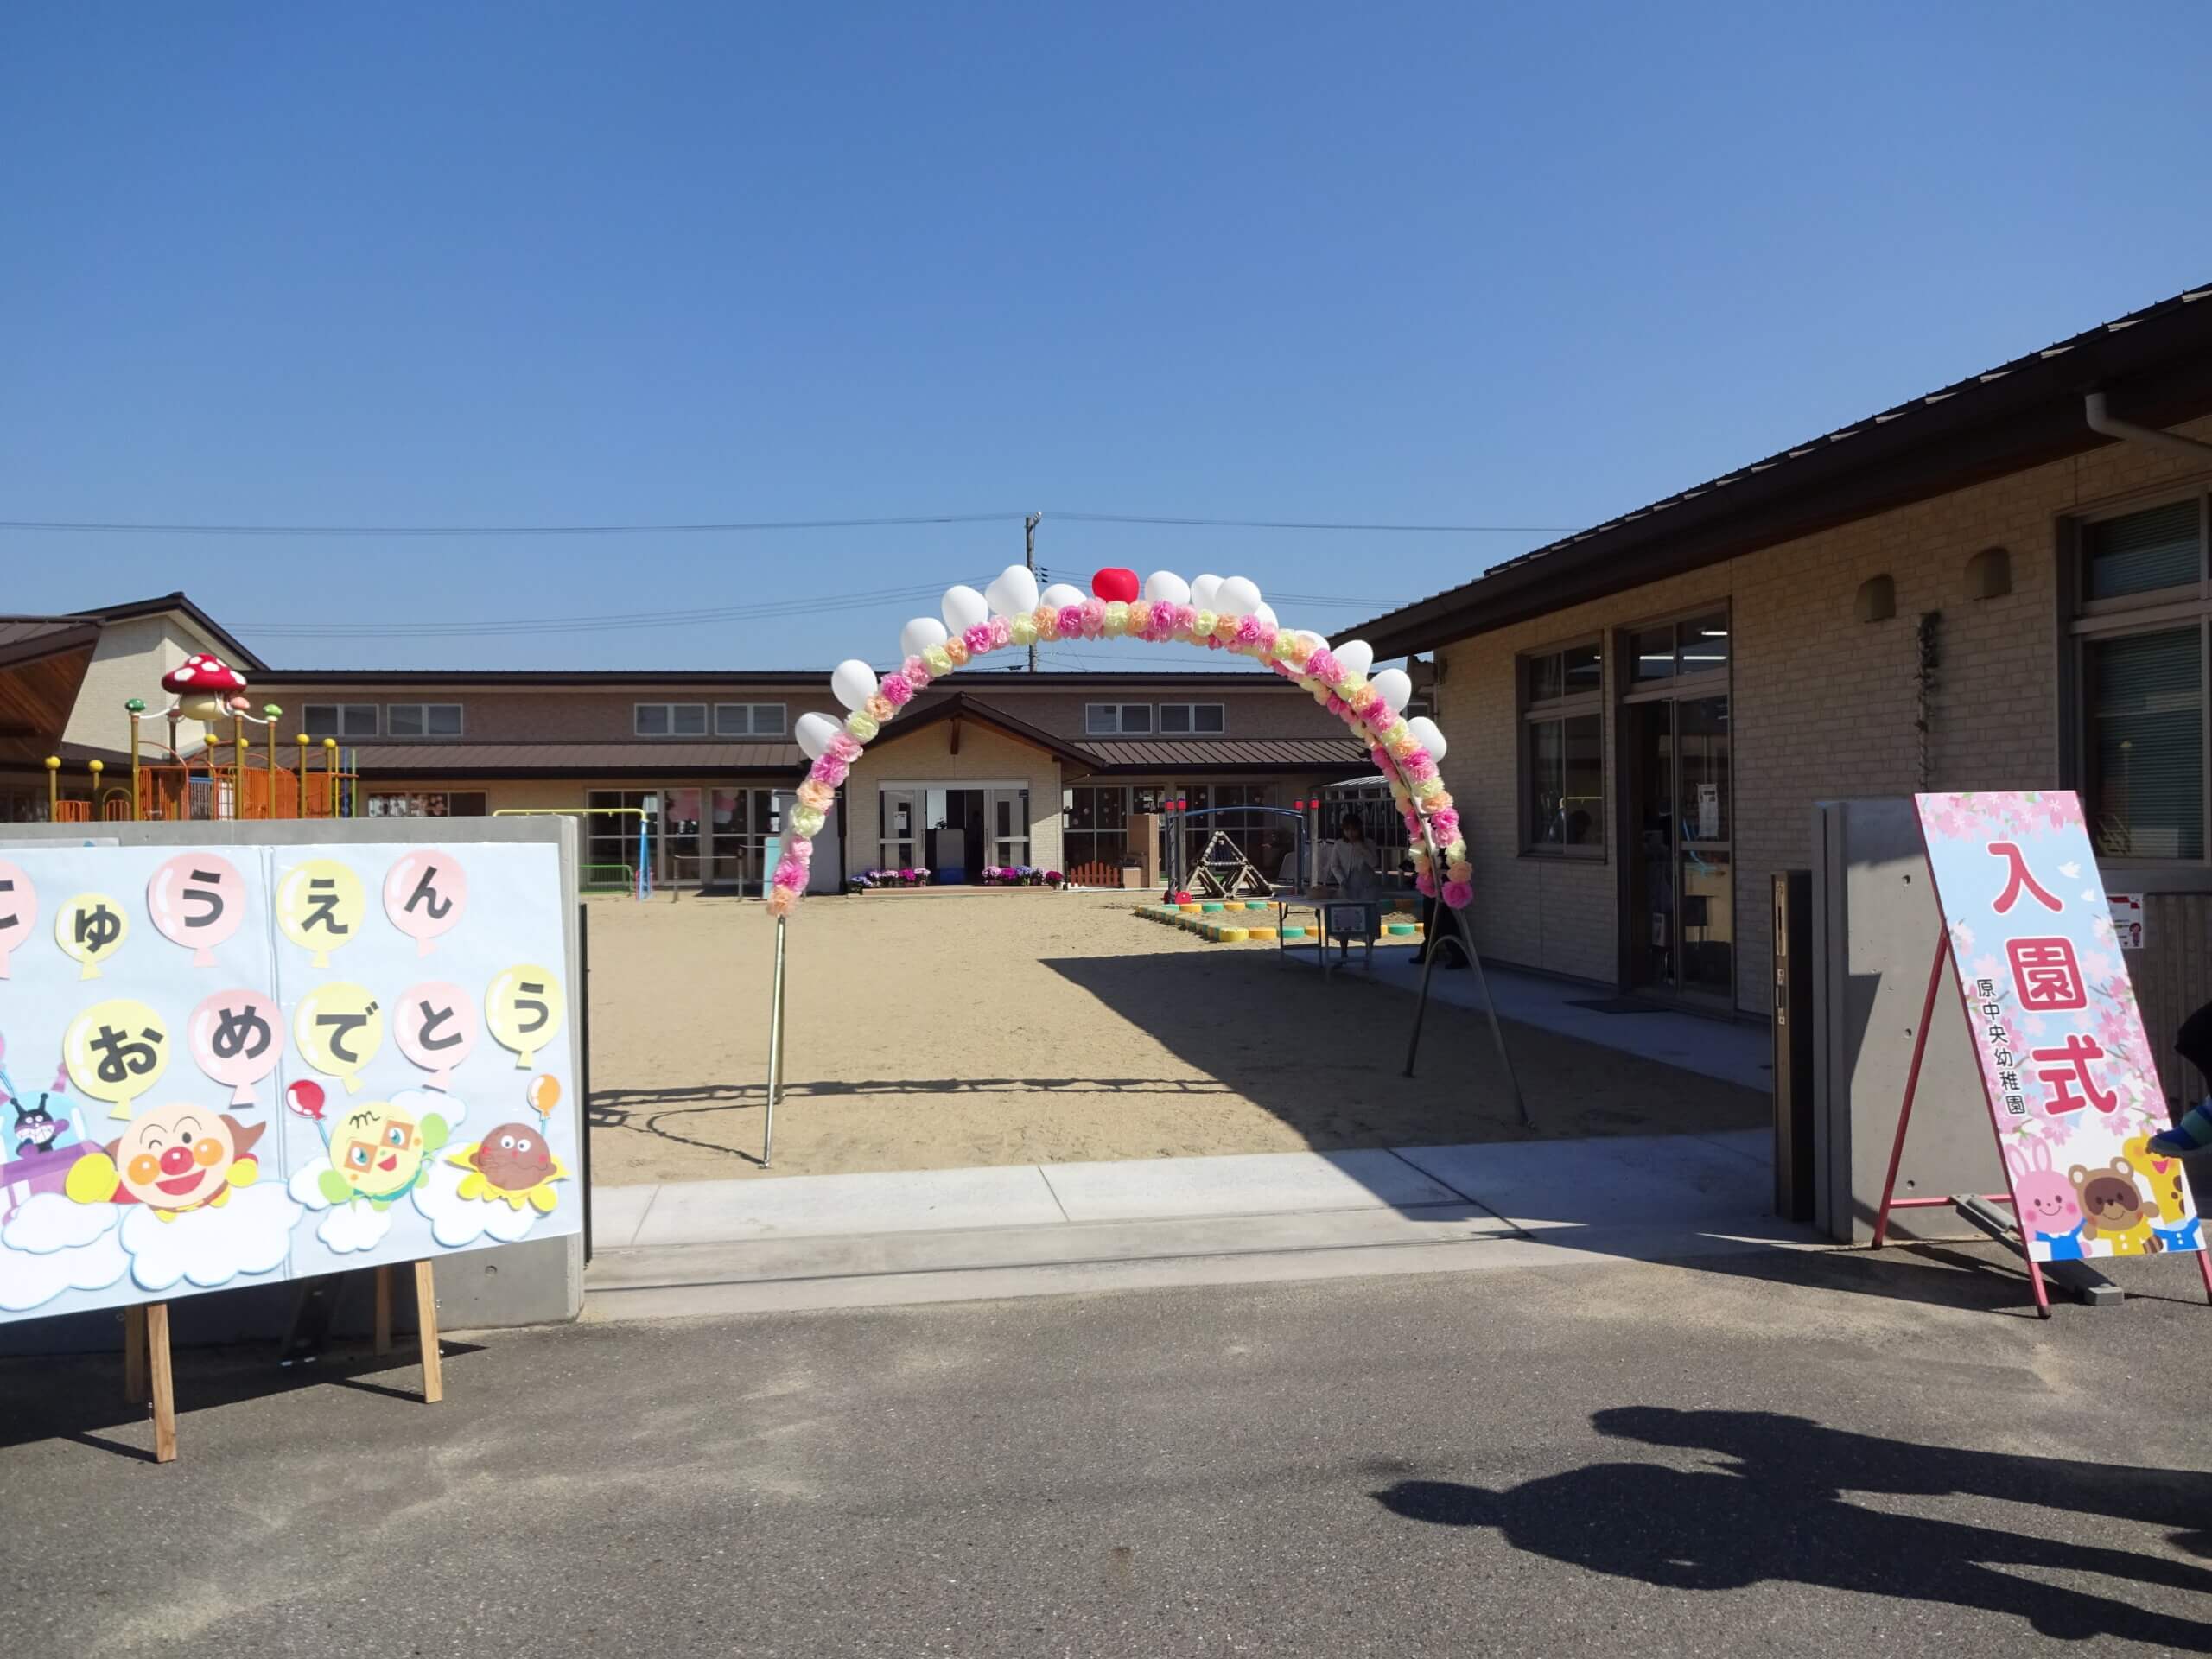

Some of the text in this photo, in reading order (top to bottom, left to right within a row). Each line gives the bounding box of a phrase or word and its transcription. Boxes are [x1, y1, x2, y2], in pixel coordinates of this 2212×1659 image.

[89, 981, 550, 1084] おめでとう
[1976, 978, 2026, 1115] 原中央幼稚園
[1987, 842, 2118, 1116] 入園式
